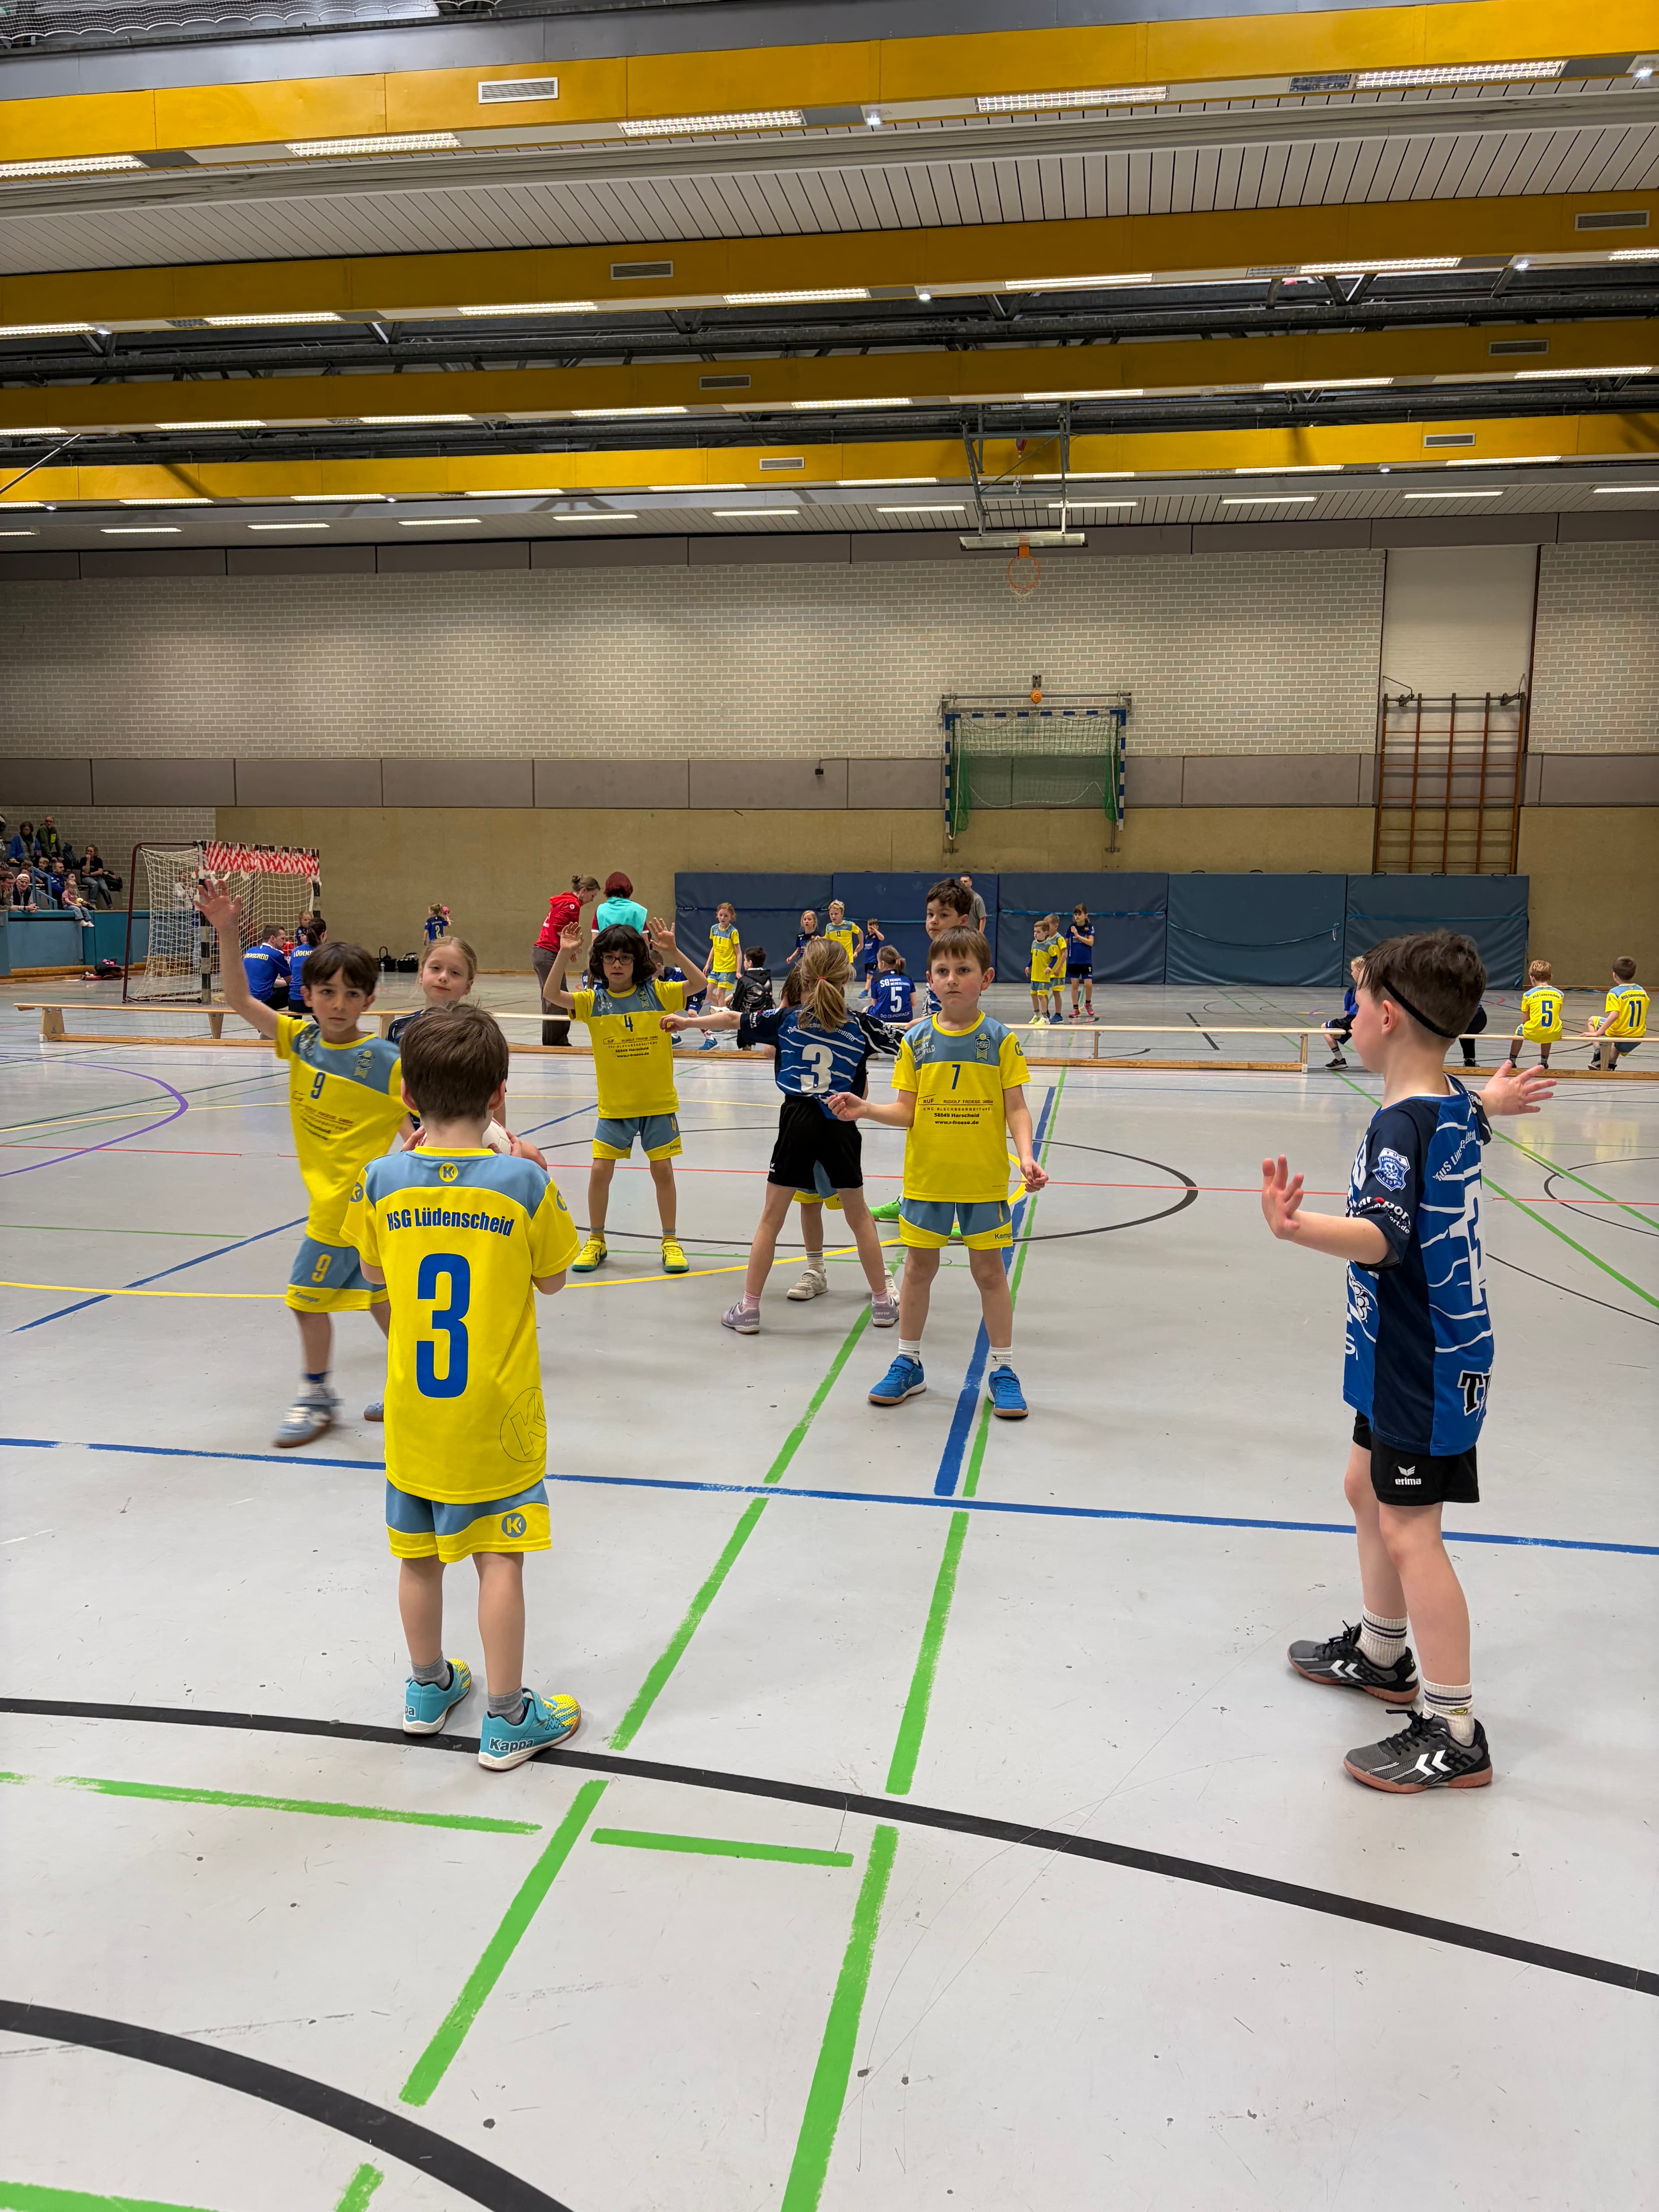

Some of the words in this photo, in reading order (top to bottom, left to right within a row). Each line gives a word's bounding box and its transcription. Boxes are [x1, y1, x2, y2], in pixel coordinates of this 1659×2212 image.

[880, 979, 890, 987] SG
[890, 986, 902, 1012] 5
[624, 1015, 633, 1032] 4
[1541, 1001, 1553, 1027] 5
[1629, 1000, 1642, 1027] 11
[801, 1044, 833, 1093] 3
[952, 1064, 960, 1090] 7
[310, 1072, 326, 1099] 9
[387, 1209, 412, 1231] HSG
[414, 1207, 515, 1236] Lüdenscheid
[311, 1254, 332, 1282] 9
[416, 1253, 470, 1398] 3
[1395, 1477, 1421, 1486] erima
[489, 1737, 534, 1754] Kappa
